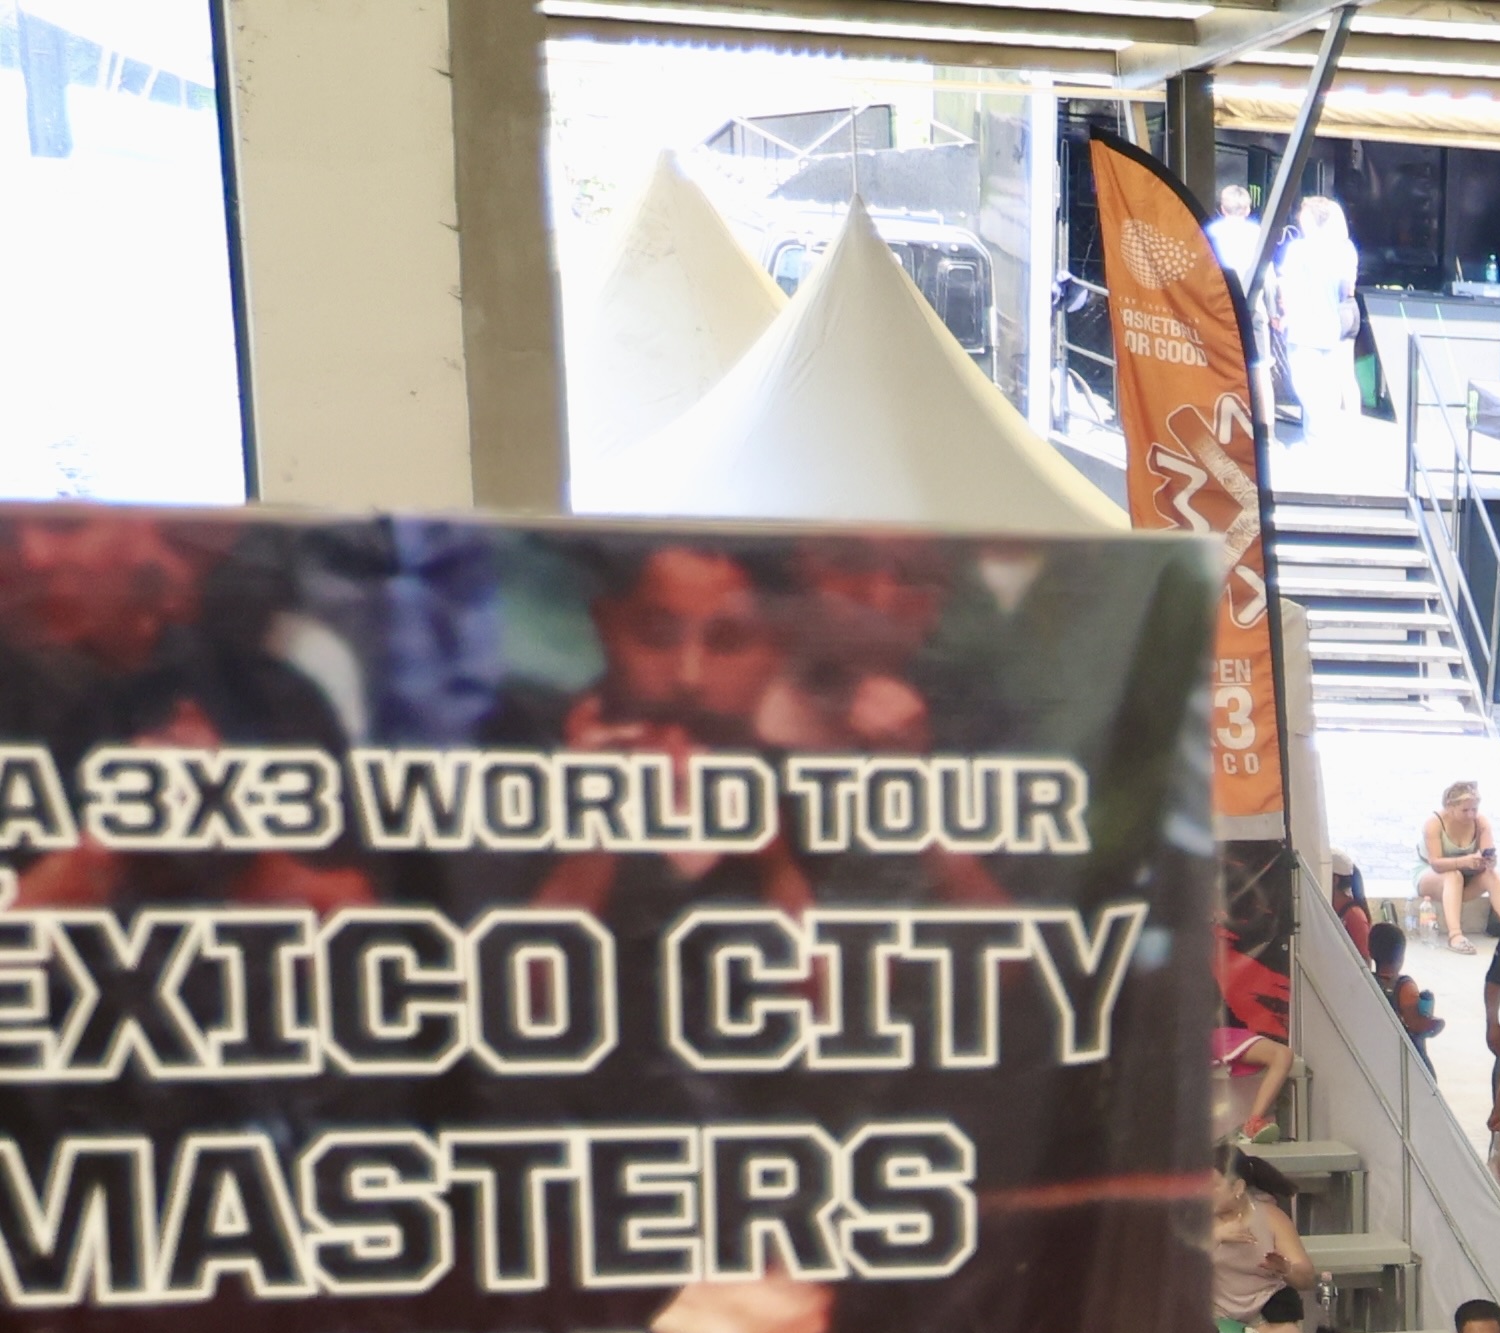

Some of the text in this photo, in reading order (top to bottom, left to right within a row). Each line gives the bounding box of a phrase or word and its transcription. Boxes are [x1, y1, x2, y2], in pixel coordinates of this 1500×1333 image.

[80, 746, 345, 850] 3X3
[349, 749, 782, 854] WORLD
[790, 754, 1092, 854] TOUR
[665, 900, 1150, 1072] CITY
[0, 1120, 979, 1308] MASTERS
